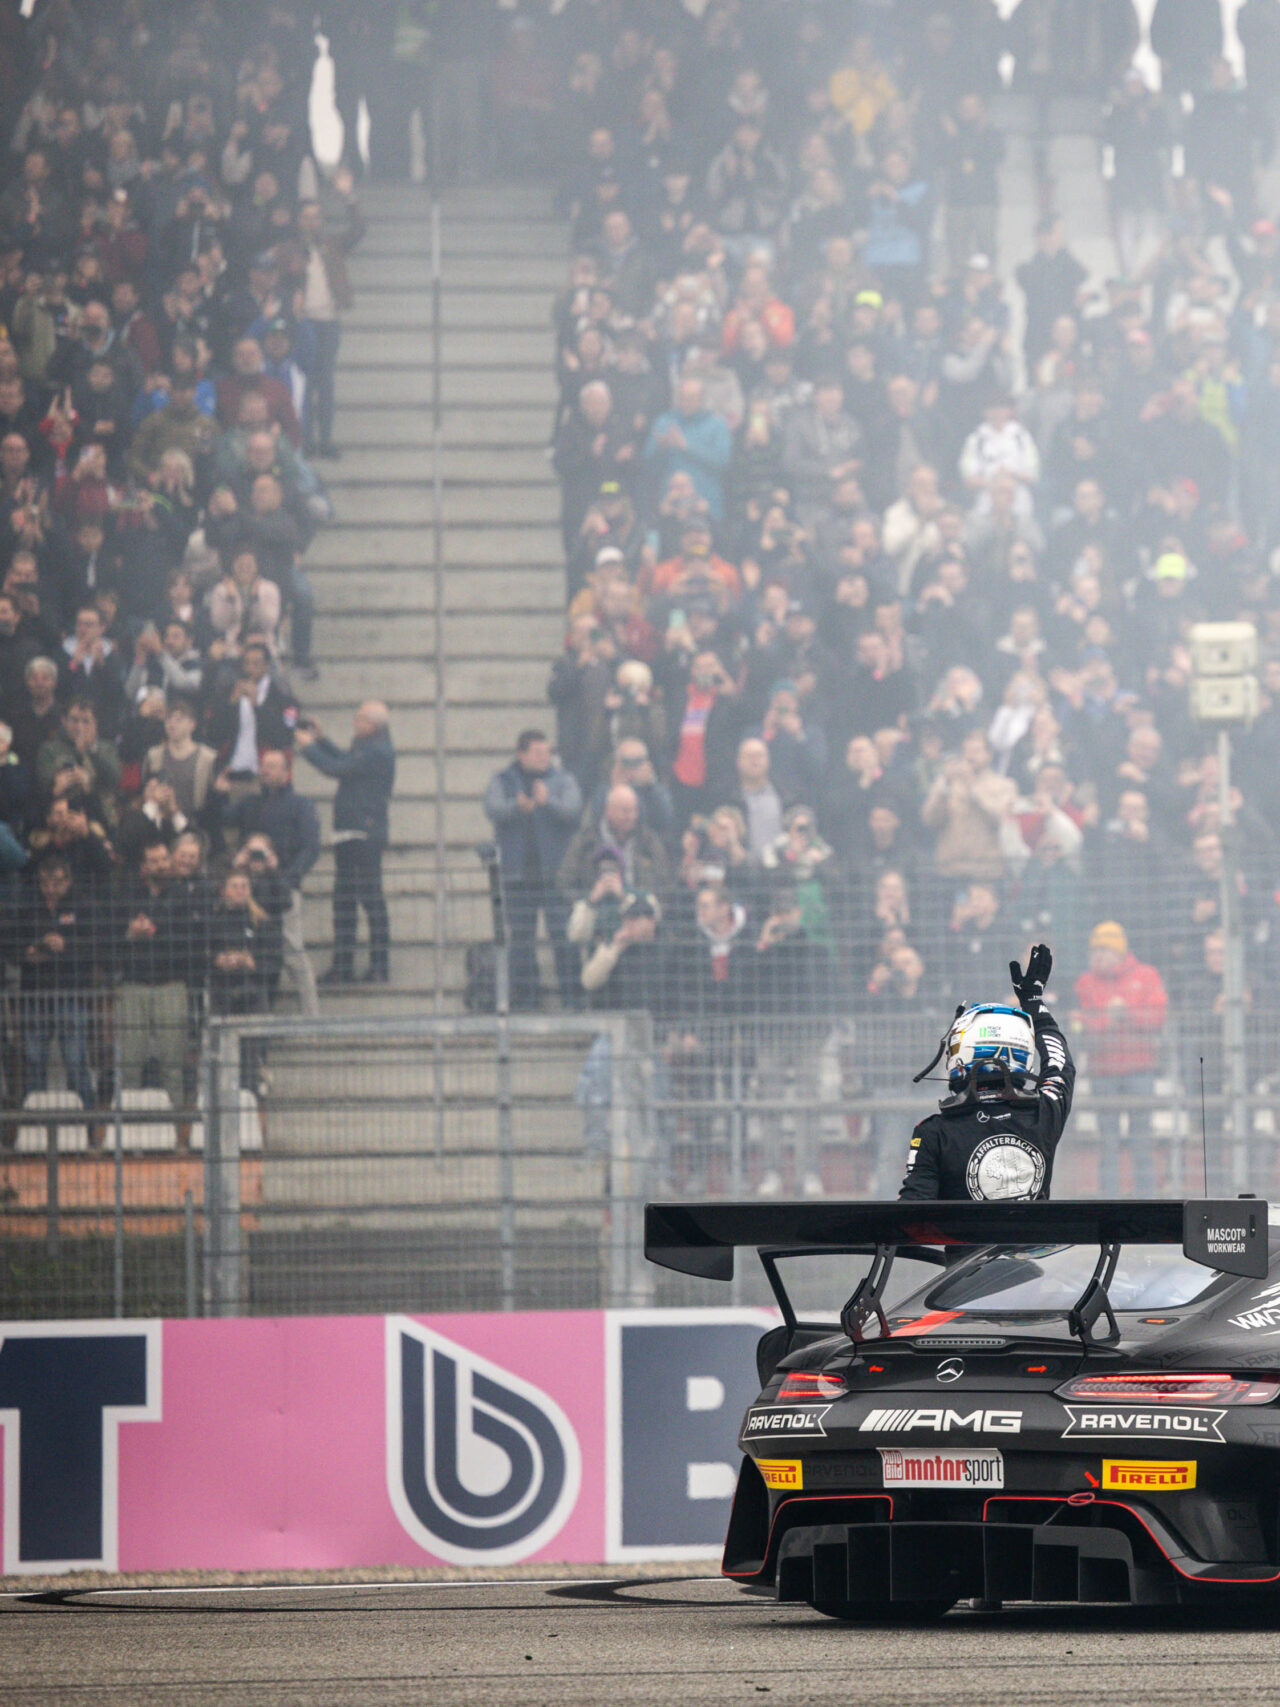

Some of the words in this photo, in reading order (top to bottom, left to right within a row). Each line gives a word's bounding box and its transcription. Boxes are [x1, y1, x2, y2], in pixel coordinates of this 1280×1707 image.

[976, 1137, 1032, 1159] AFFALTERBACH
[1207, 1242, 1246, 1253] WORKWEAR
[748, 1413, 816, 1430] RAVENOL
[1081, 1414, 1208, 1432] RAVENOL
[1110, 1465, 1188, 1484] PIRELLI
